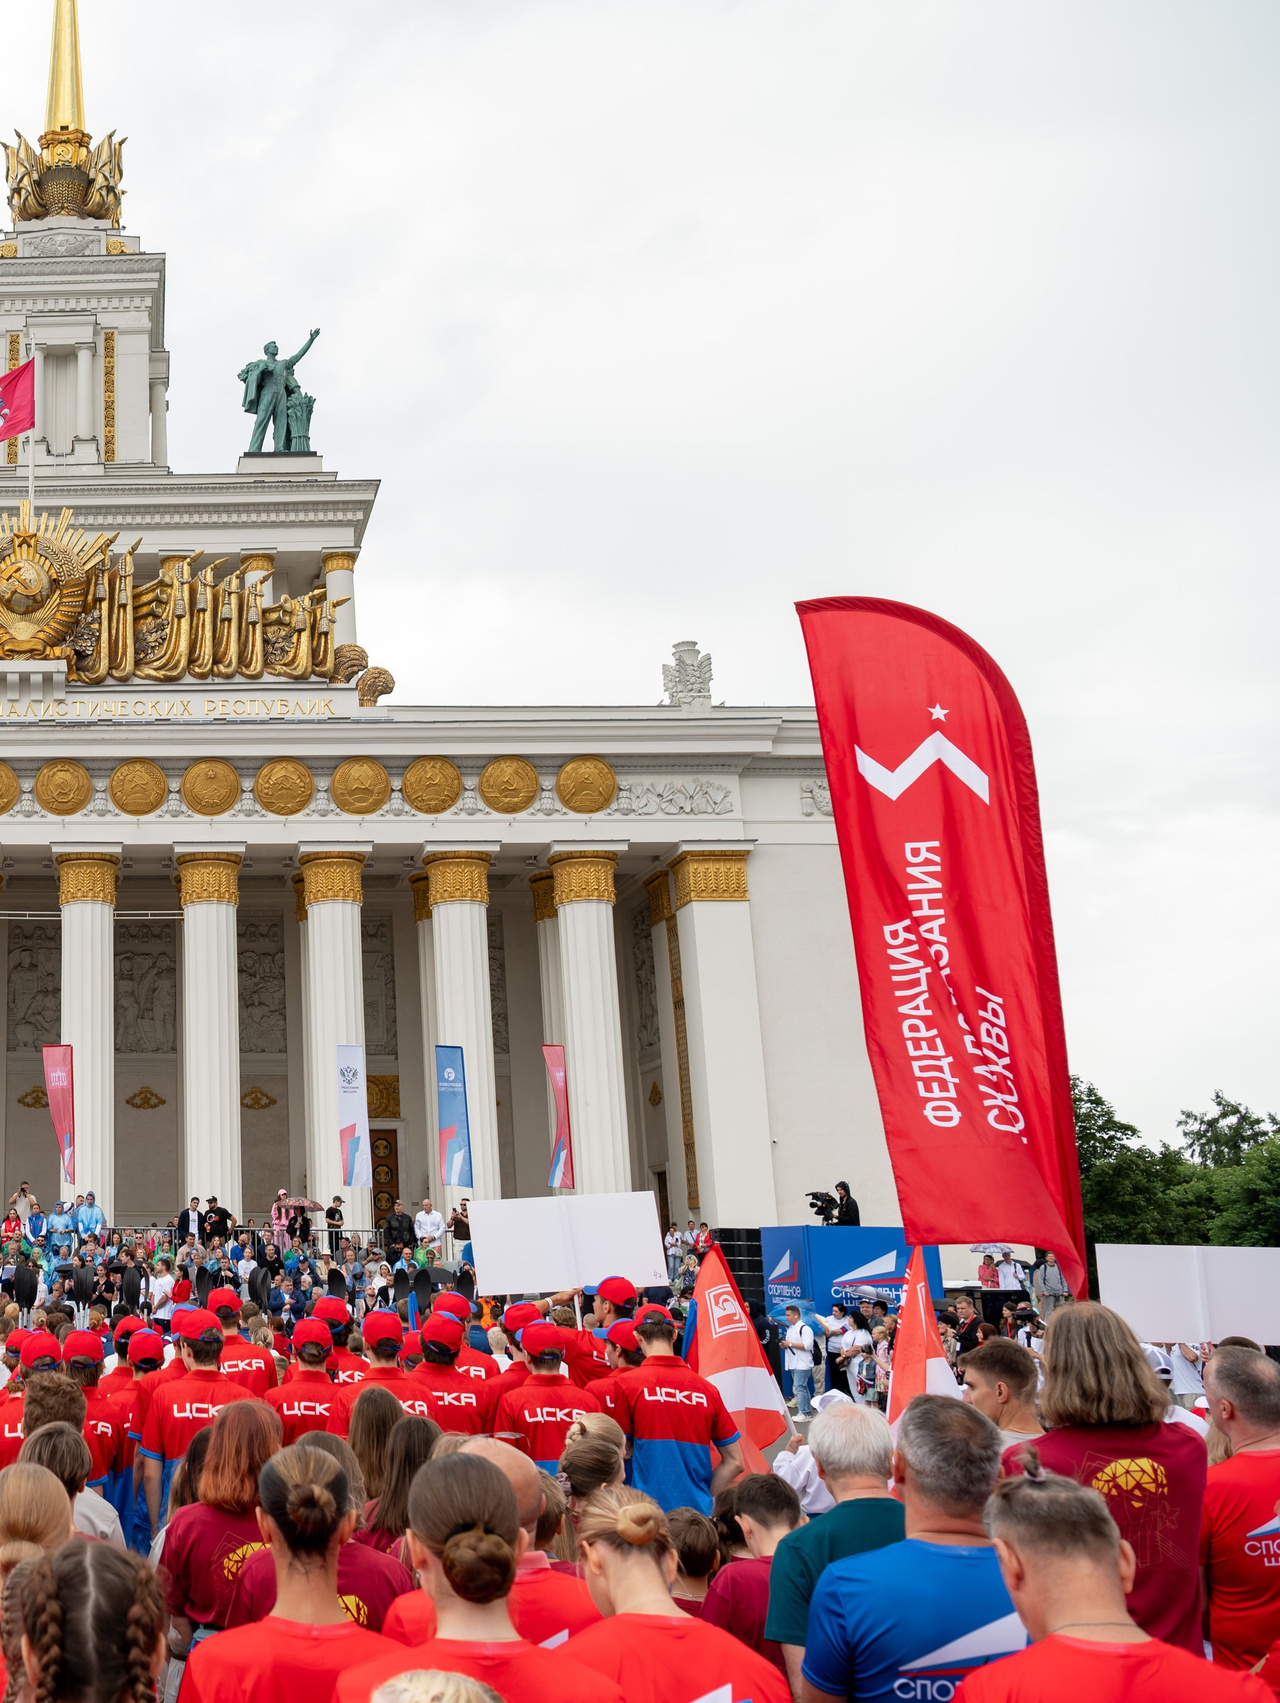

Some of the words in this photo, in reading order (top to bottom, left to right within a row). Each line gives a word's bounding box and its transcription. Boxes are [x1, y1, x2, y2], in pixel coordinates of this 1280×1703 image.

[204, 699, 336, 716] РЕСПУБЛИК
[883, 918, 962, 1128] ФЕДЕРАЦИЯ
[431, 1391, 477, 1407] СКА
[643, 1386, 708, 1408] ЦСКА
[173, 1402, 226, 1419] ЦСК
[282, 1401, 332, 1417] ЦСК
